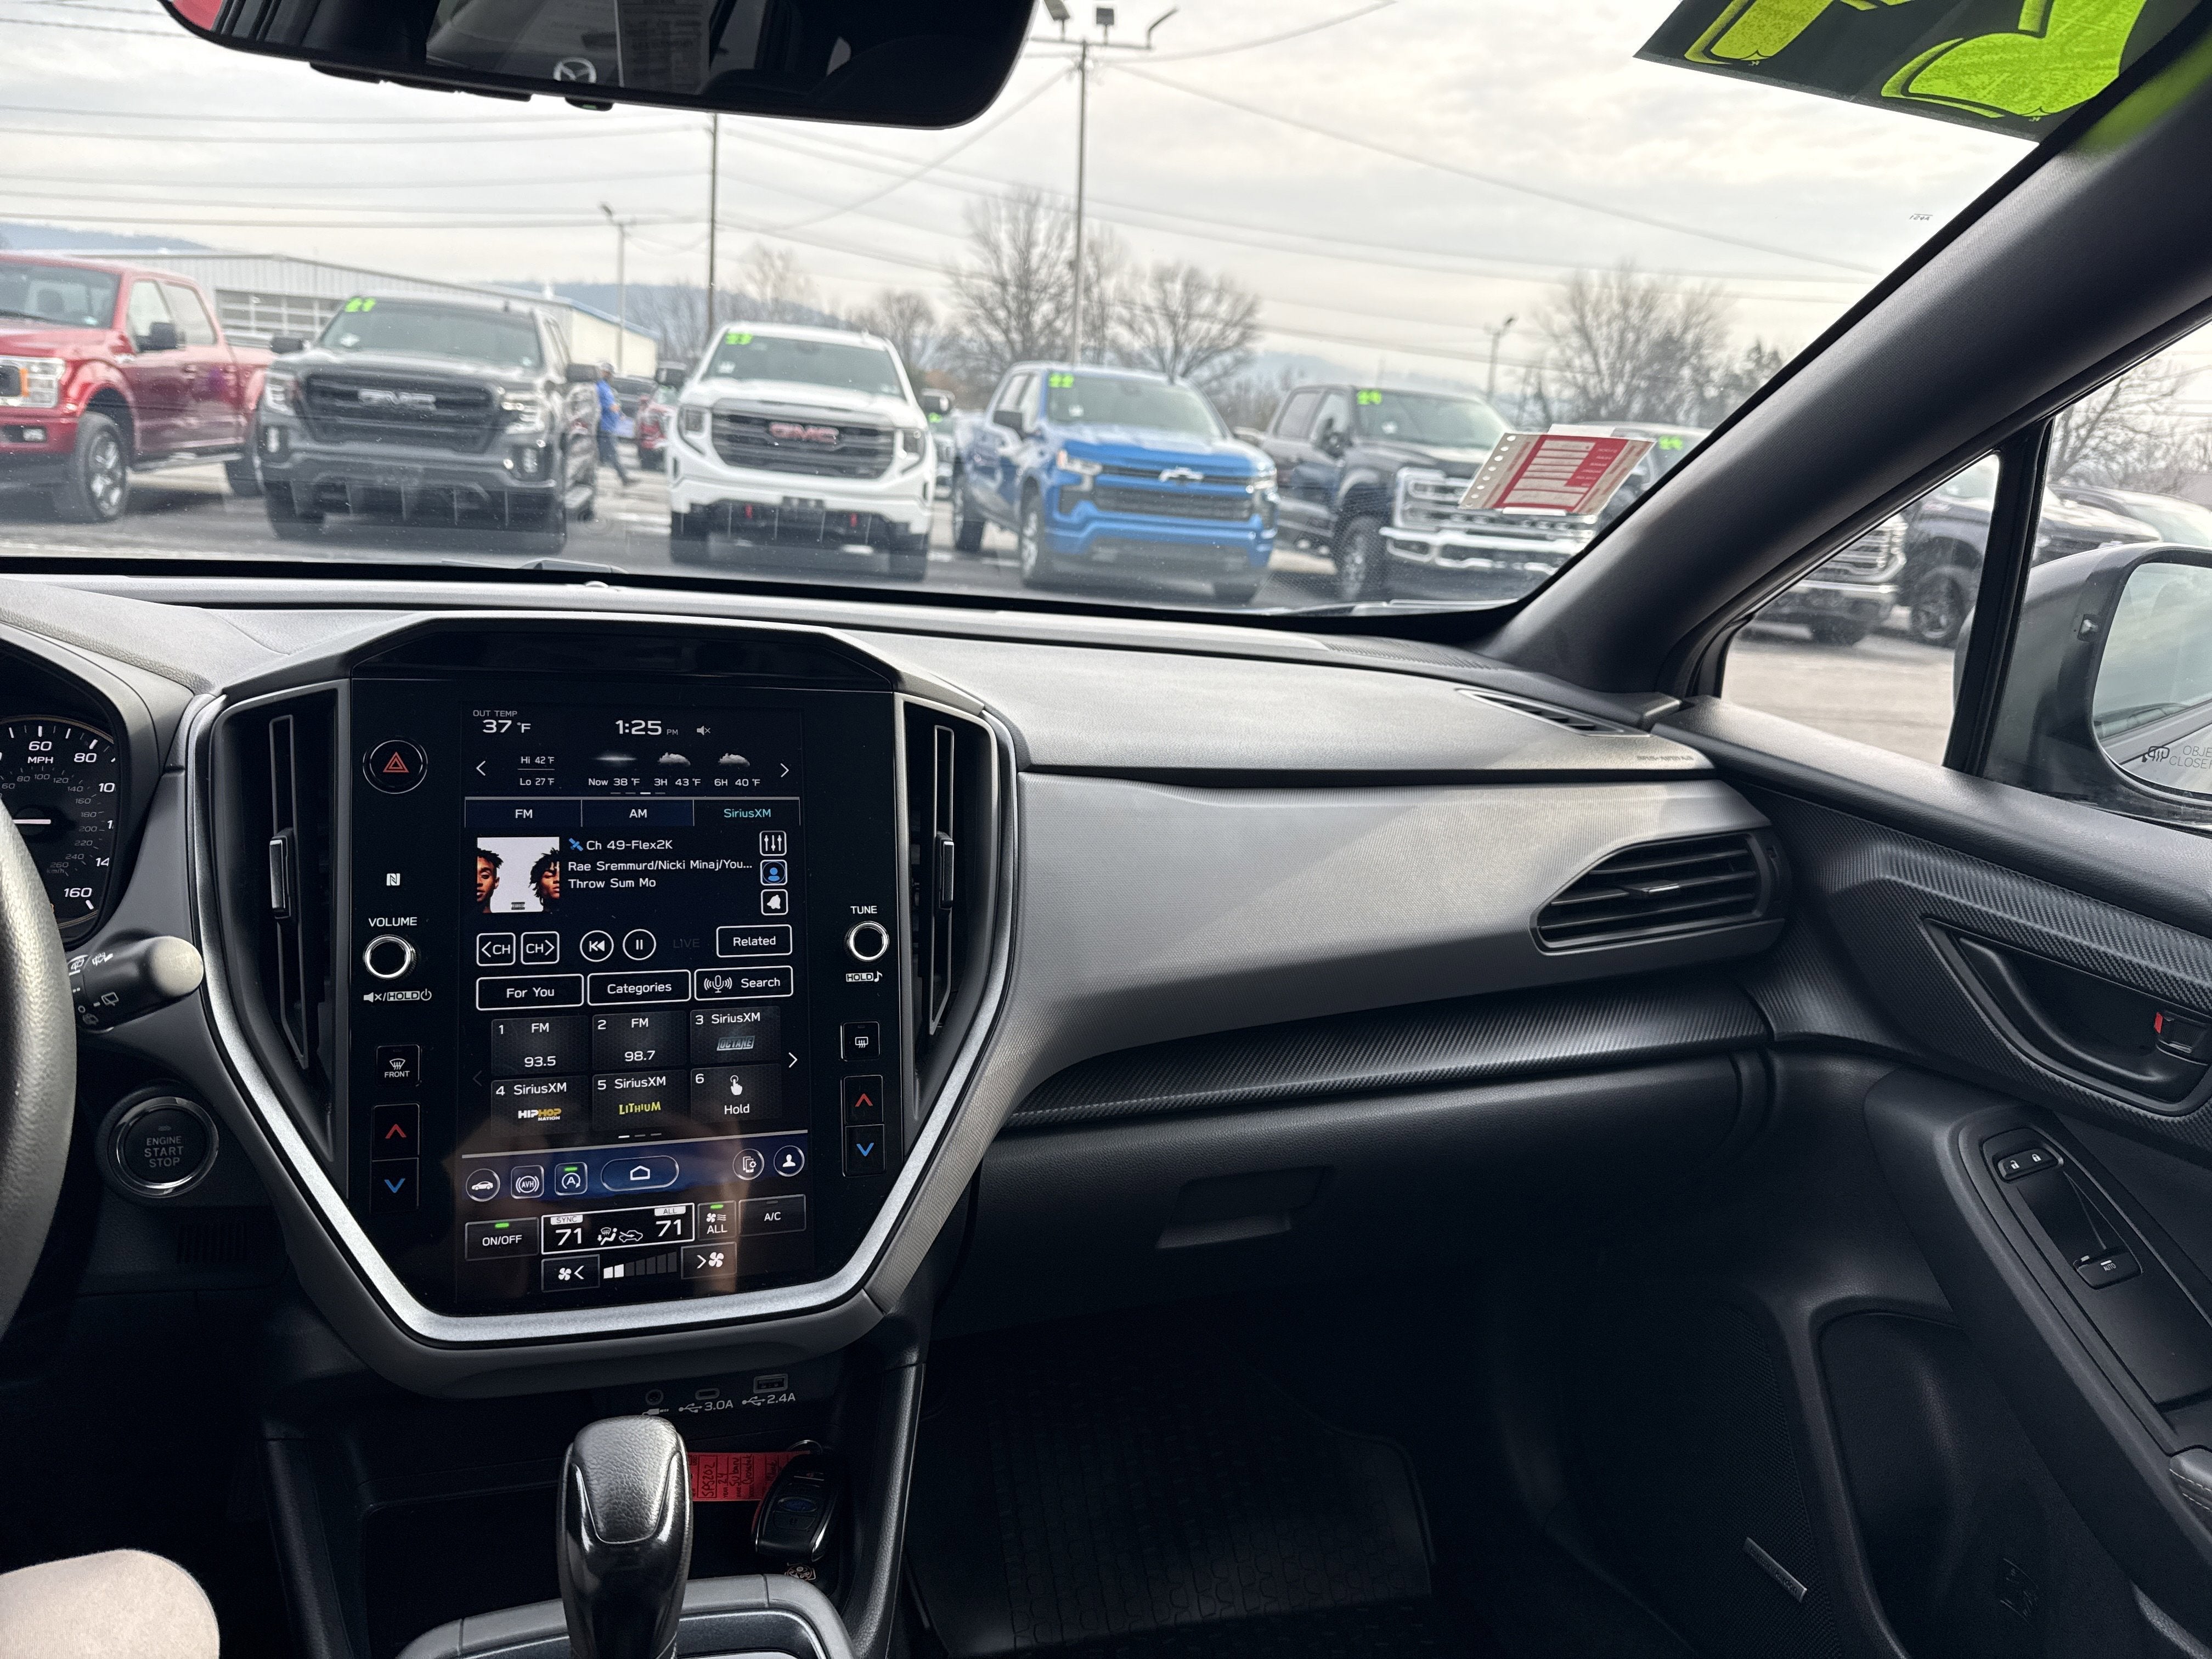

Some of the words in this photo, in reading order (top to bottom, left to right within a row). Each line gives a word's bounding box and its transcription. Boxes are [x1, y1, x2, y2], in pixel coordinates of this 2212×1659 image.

[483, 719, 512, 733] 37
[615, 720, 662, 735] 1:25
[29, 741, 52, 751] 60
[74, 753, 97, 763] 80
[521, 756, 531, 764] Hi
[535, 756, 546, 764] 42
[520, 777, 532, 786] Lo
[535, 777, 546, 786] 27
[589, 778, 608, 786] Now
[613, 778, 628, 786] 38
[654, 778, 668, 786] 3H
[675, 778, 690, 786] 43
[714, 778, 728, 786] 6H
[735, 778, 749, 786] 40
[99, 783, 116, 793] 10
[515, 809, 533, 819] FM
[629, 809, 647, 818] AM
[724, 808, 771, 818] SiriusXM
[586, 840, 602, 850] Ch
[607, 839, 673, 850] 49-Flex2K
[95, 857, 110, 867] 14
[568, 862, 591, 871] Rae
[596, 860, 685, 871] Sremmurd/Nicki
[568, 879, 605, 888] Throw
[610, 878, 635, 888] Sum
[639, 878, 656, 887] Mo
[64, 888, 92, 898] 160
[850, 905, 878, 914] TUNE
[368, 917, 417, 927] VOLUME
[673, 938, 700, 949] LIVE
[733, 936, 776, 946] Related
[493, 944, 511, 955] CH
[526, 943, 544, 953] CH
[847, 973, 873, 981] HOLD
[741, 977, 781, 988] Search
[506, 988, 527, 998] For
[532, 988, 555, 997] You
[607, 982, 672, 995] Categories
[388, 991, 419, 1001] HOLD
[597, 1020, 607, 1029] 2
[631, 1018, 649, 1028] FM
[695, 1014, 704, 1025] 3
[711, 1012, 761, 1024] SiriusXM
[498, 1025, 504, 1035] 1
[531, 1023, 549, 1032] FM
[624, 1050, 656, 1061] 98.7
[524, 1056, 556, 1068] 93.5
[597, 1080, 607, 1090] 5
[614, 1076, 667, 1089] SiriusXM
[695, 1074, 704, 1084] 6
[496, 1086, 505, 1096] 4
[514, 1082, 567, 1095] SiriusXM
[724, 1104, 750, 1115] Hold
[146, 1136, 182, 1146] ENGINE
[144, 1146, 184, 1158] START
[149, 1157, 180, 1167] STOP
[764, 1211, 781, 1222] A/C
[658, 1220, 682, 1237] 71
[707, 1224, 727, 1234] ALL
[482, 1234, 522, 1246] ON/OFF
[555, 1228, 582, 1245] 71
[2103, 1263, 2117, 1271] AUTO
[766, 1392, 796, 1403] 2.4A
[704, 1400, 734, 1411] 3.0A
